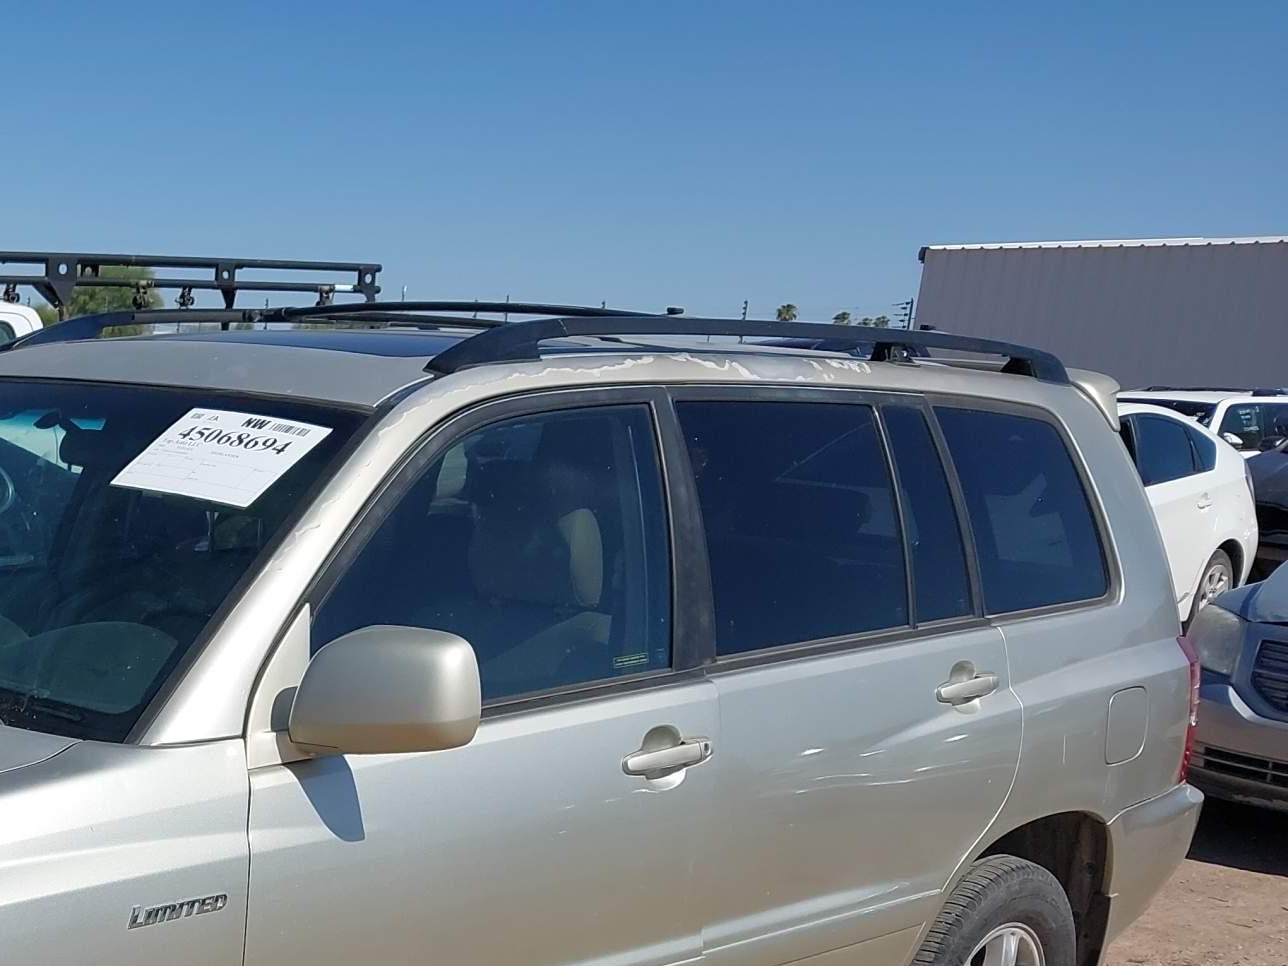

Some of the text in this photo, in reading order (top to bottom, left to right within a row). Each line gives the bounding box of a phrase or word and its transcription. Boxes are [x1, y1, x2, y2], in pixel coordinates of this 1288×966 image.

[242, 417, 272, 430] NW
[178, 425, 293, 455] 45068694
[128, 893, 228, 929] LIMITED
